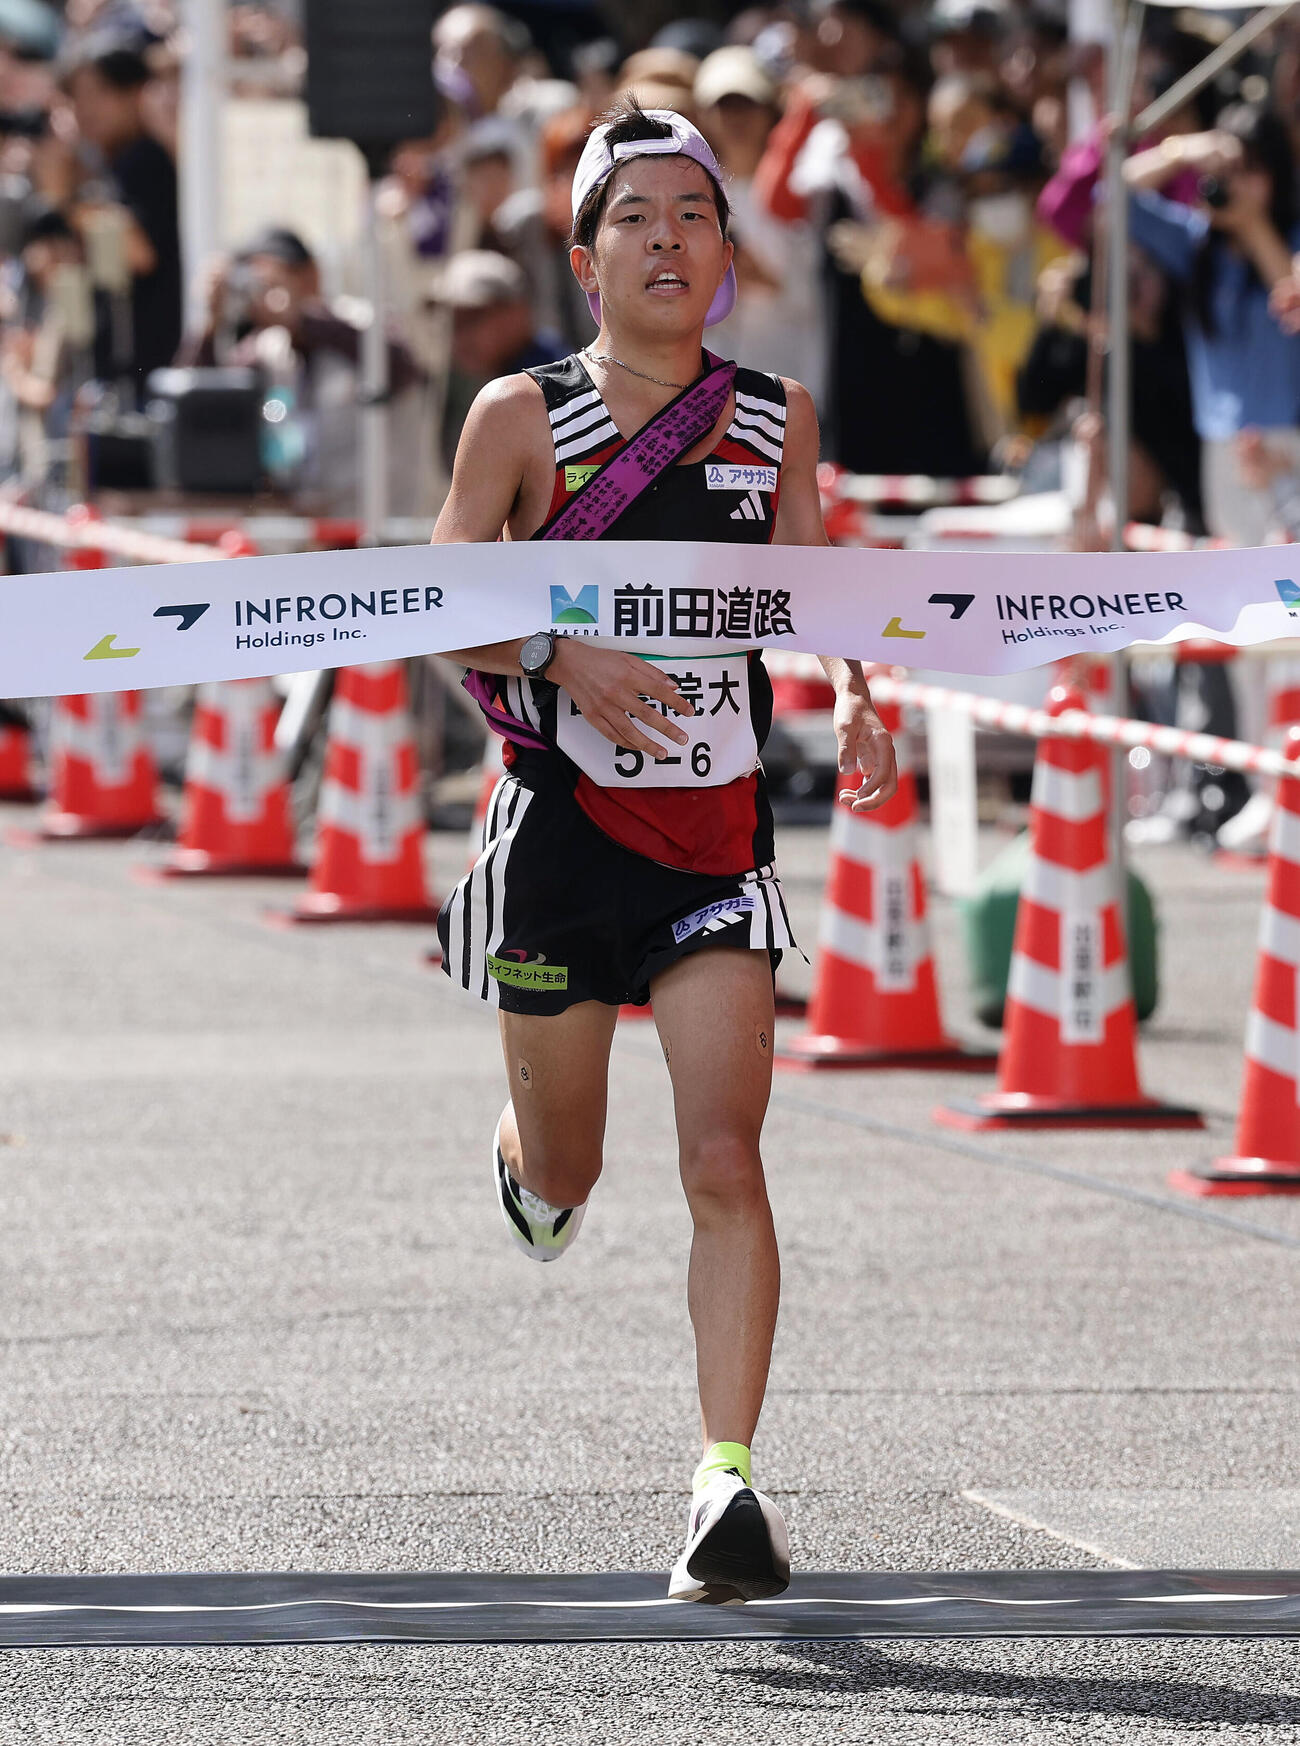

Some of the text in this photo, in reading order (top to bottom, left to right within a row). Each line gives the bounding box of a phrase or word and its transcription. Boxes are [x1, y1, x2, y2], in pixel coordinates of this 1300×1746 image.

[728, 469, 776, 487] アサガミ
[235, 586, 444, 627] INFRONEER
[613, 582, 798, 640] 前田道路
[995, 591, 1189, 621] INFRONEER
[236, 627, 368, 650] Holdings Inc.
[1001, 622, 1127, 645] Holdings Inc.
[694, 897, 756, 925] アサガミ
[487, 960, 567, 984] ライフネット生命
